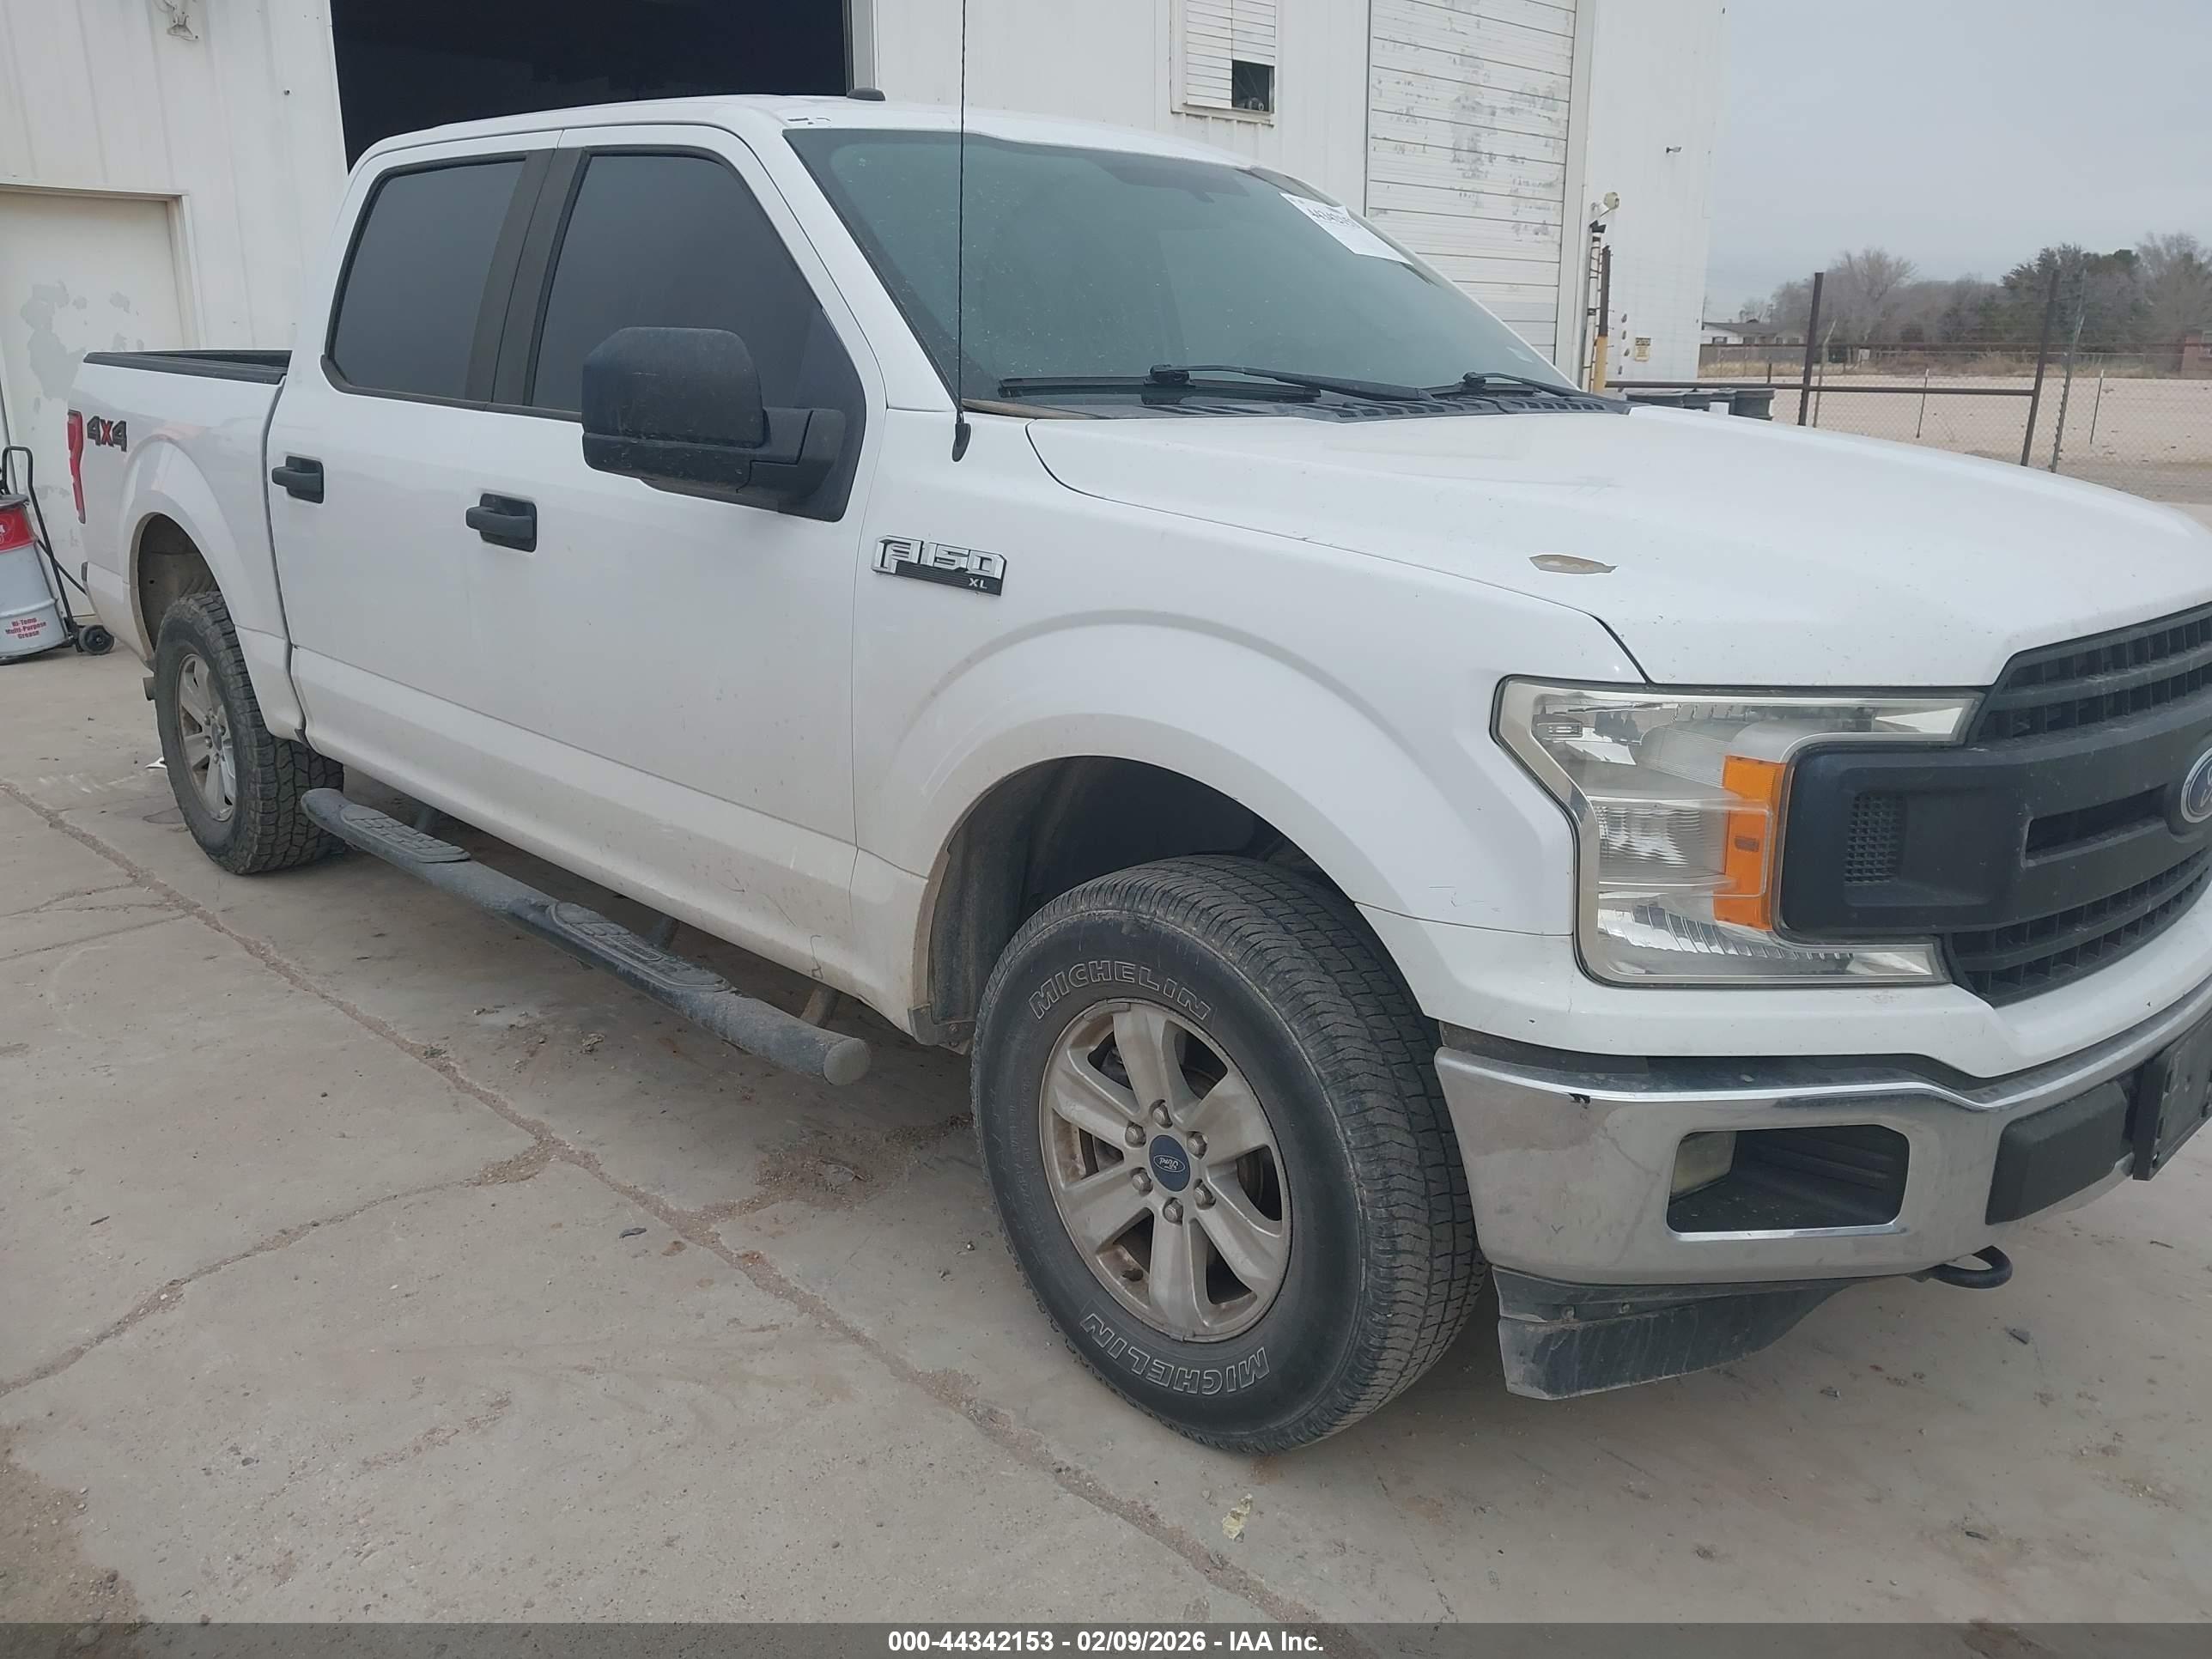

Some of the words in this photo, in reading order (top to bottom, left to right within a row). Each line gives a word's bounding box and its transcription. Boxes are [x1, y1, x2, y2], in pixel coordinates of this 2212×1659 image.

[968, 577, 988, 590] XL
[1029, 960, 1212, 1020] MICHELIN
[1079, 1313, 1270, 1395] MICHELIN
